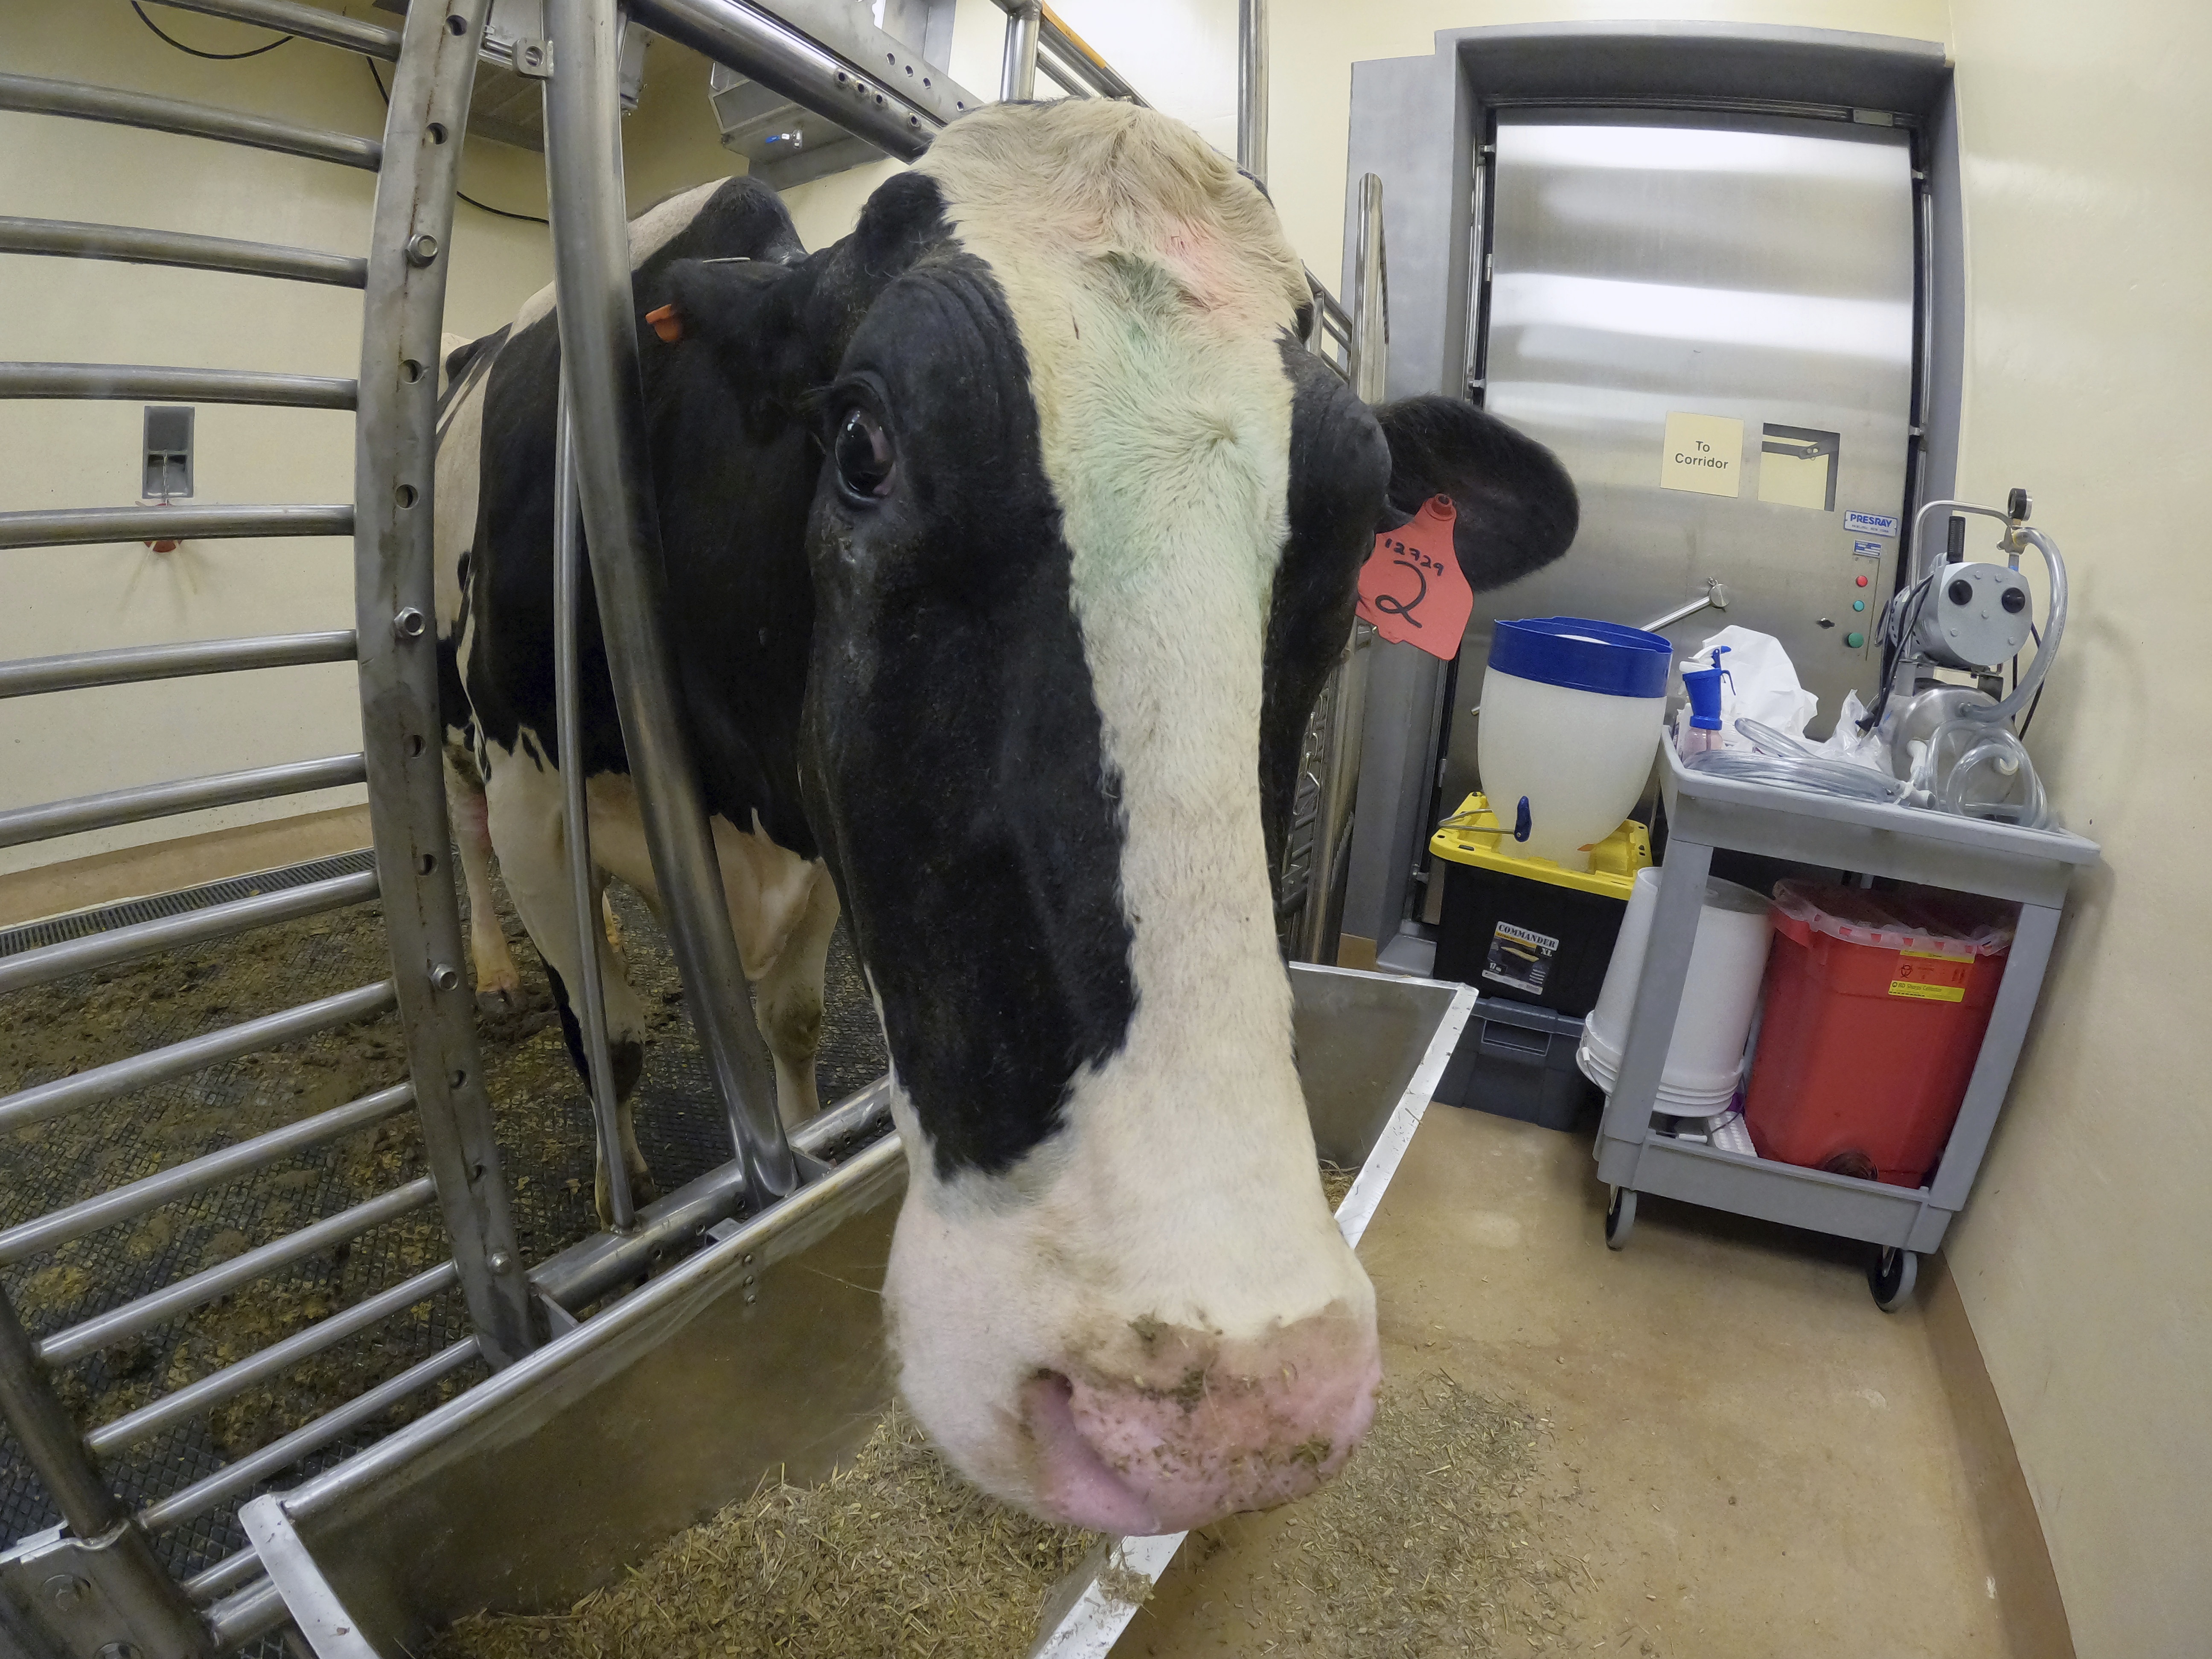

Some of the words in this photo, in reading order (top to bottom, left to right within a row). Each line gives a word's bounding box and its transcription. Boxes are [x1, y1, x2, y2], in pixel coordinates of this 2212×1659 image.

[1695, 440, 1710, 452] To
[1675, 453, 1729, 469] Corridor
[1850, 513, 1892, 527] PRESRAY
[1375, 559, 1427, 629] 2
[1498, 924, 1555, 948] COMMANDER
[1540, 947, 1553, 957] XL
